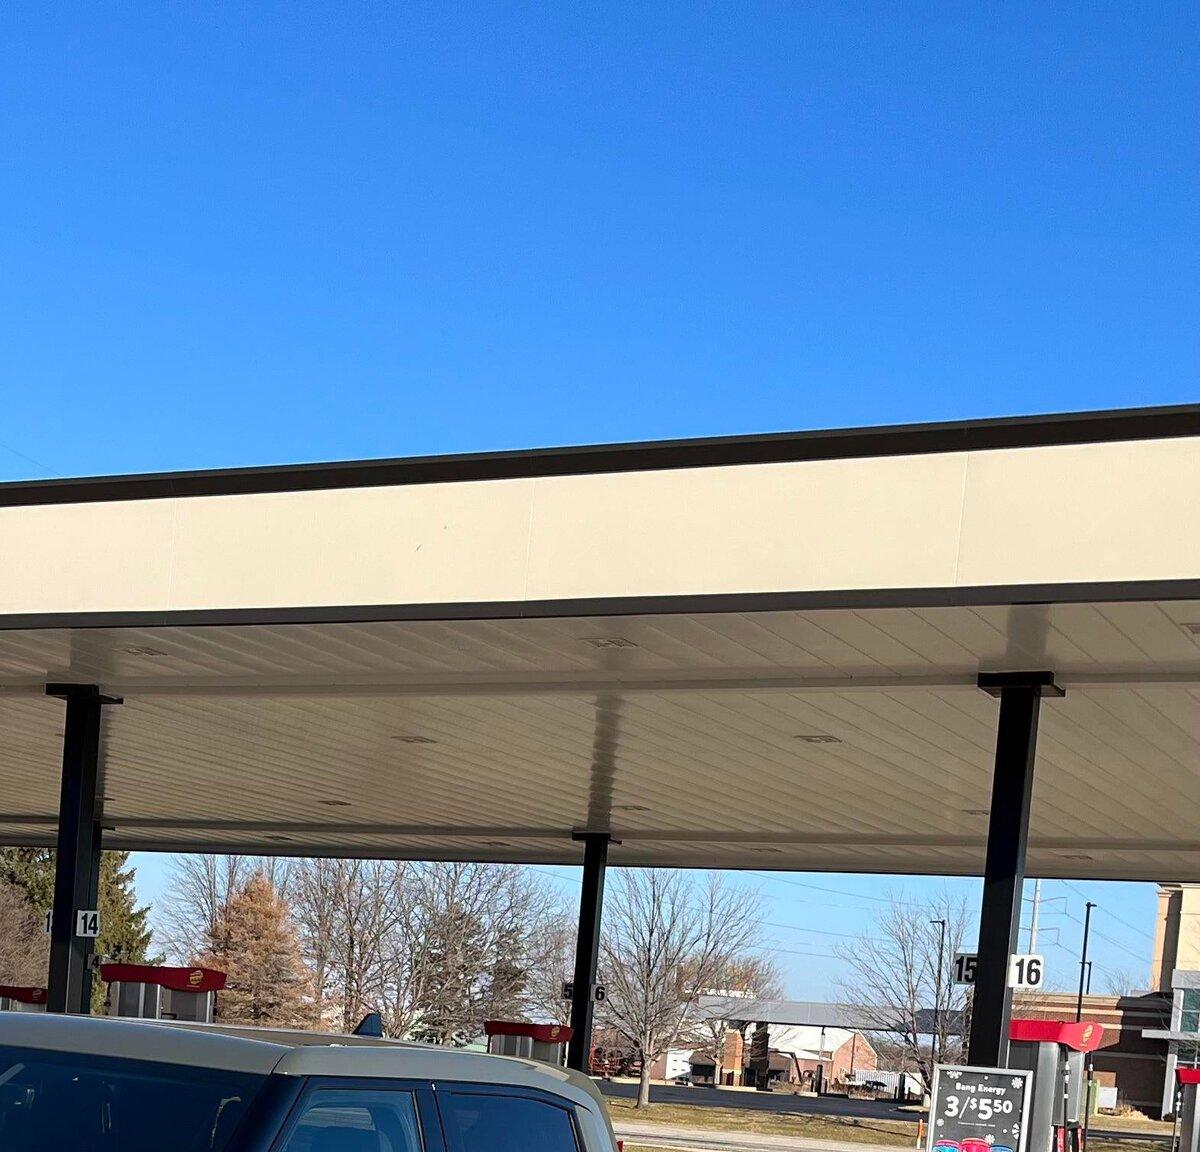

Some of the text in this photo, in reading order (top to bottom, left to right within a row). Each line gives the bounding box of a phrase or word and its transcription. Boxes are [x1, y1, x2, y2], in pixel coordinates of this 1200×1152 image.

[82, 913, 99, 934] 14
[955, 955, 977, 982] 15
[1015, 958, 1041, 985] 16
[595, 986, 605, 1000] 6
[955, 1082, 1006, 1096] Bang Energy
